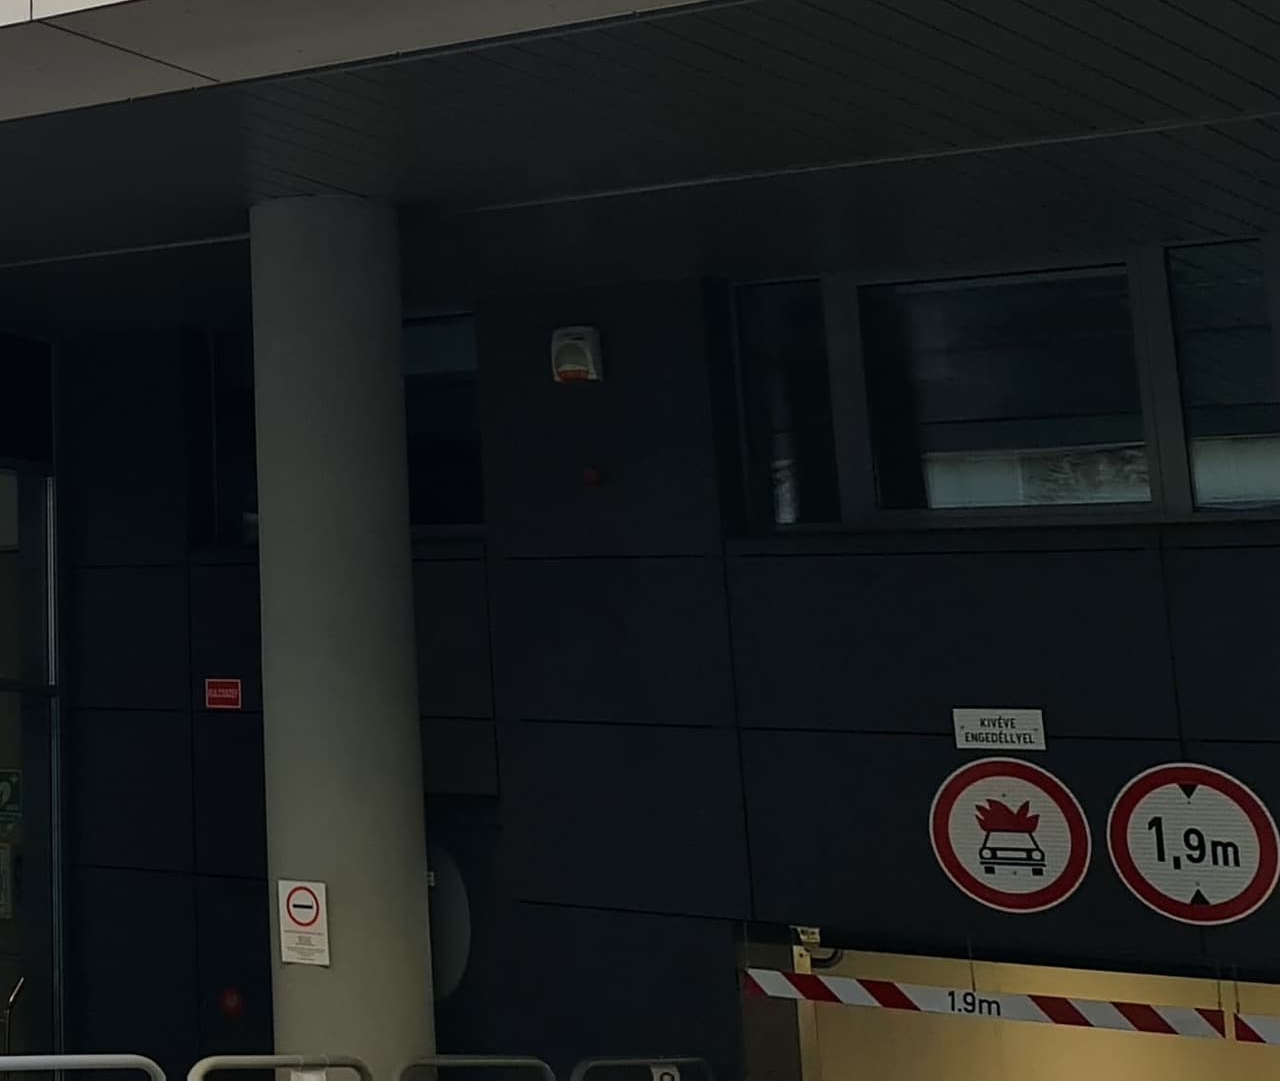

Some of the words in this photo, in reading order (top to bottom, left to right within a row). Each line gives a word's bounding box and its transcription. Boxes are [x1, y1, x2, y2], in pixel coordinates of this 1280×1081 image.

[980, 715, 1016, 729] KIVÉVE
[964, 730, 1035, 744] ENGEDÉLLYEL
[948, 990, 1001, 1016] 1.9m
